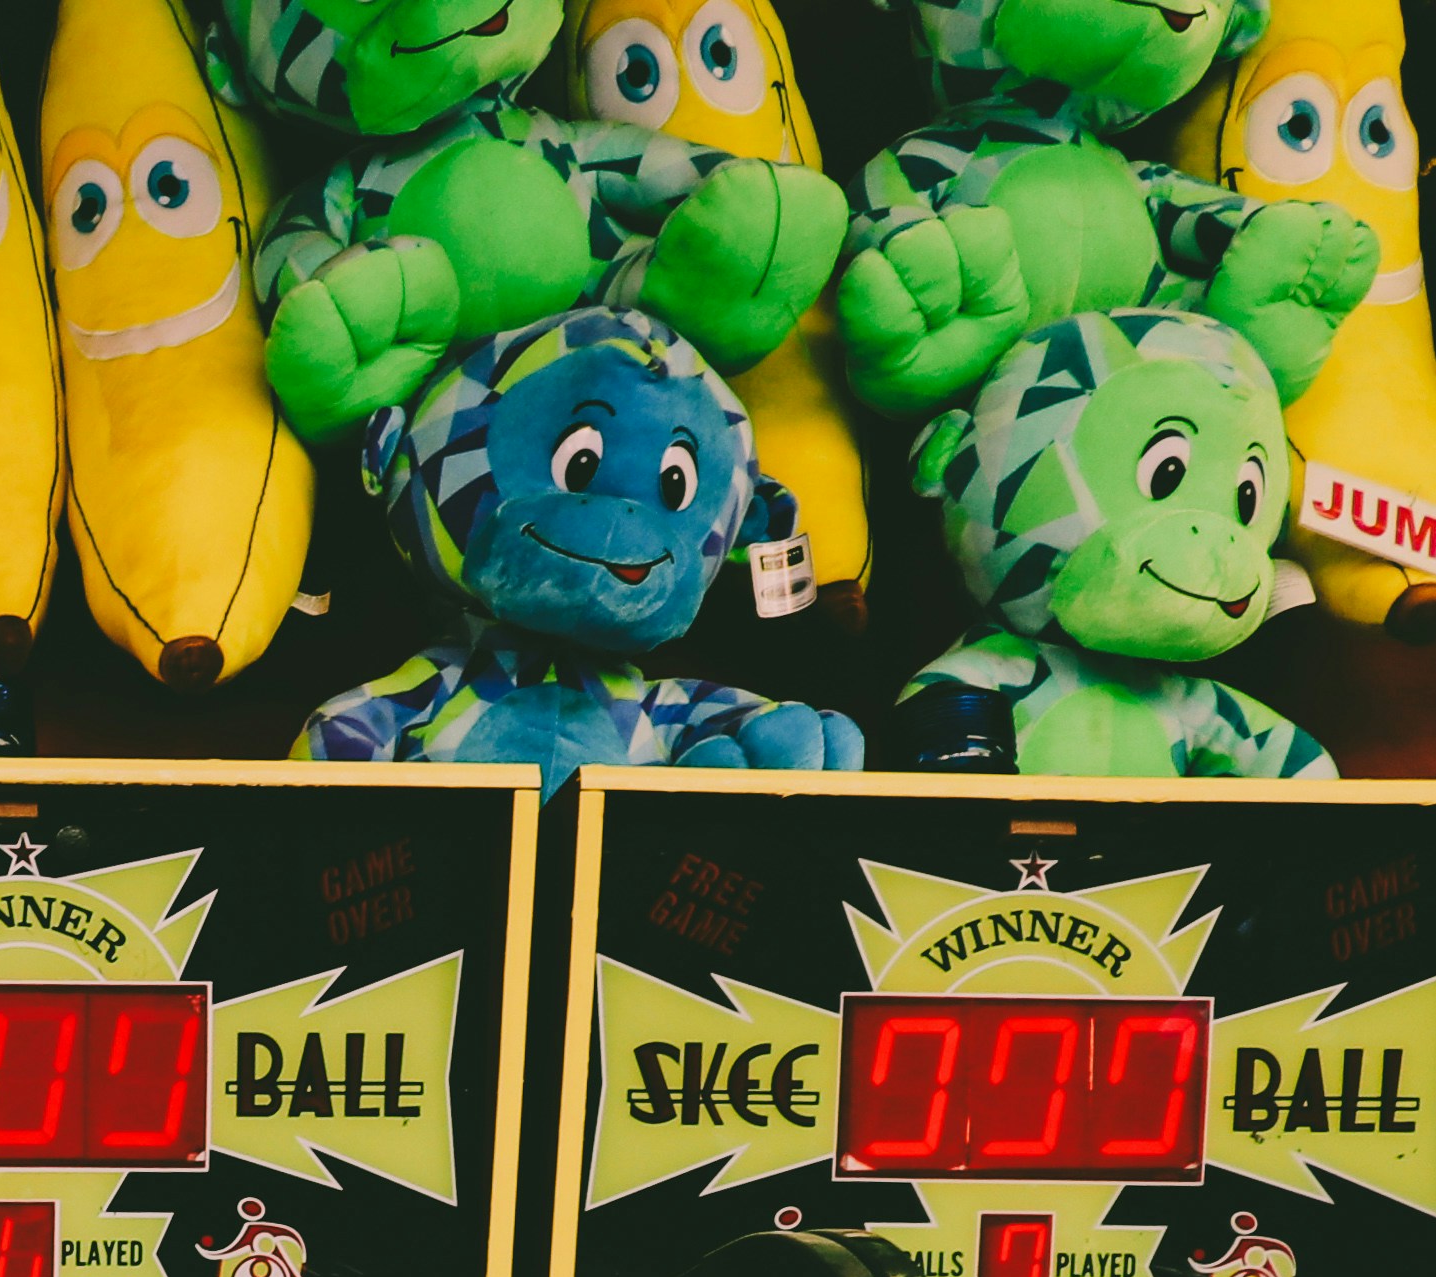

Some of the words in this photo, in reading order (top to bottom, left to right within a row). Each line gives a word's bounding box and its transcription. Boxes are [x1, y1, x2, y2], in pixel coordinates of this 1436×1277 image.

[921, 909, 1133, 978] WINNER
[226, 1031, 424, 1119] BALL
[627, 1041, 821, 1128] SKEE
[1223, 1047, 1421, 1134] BALL
[61, 1240, 144, 1267] PLAYED
